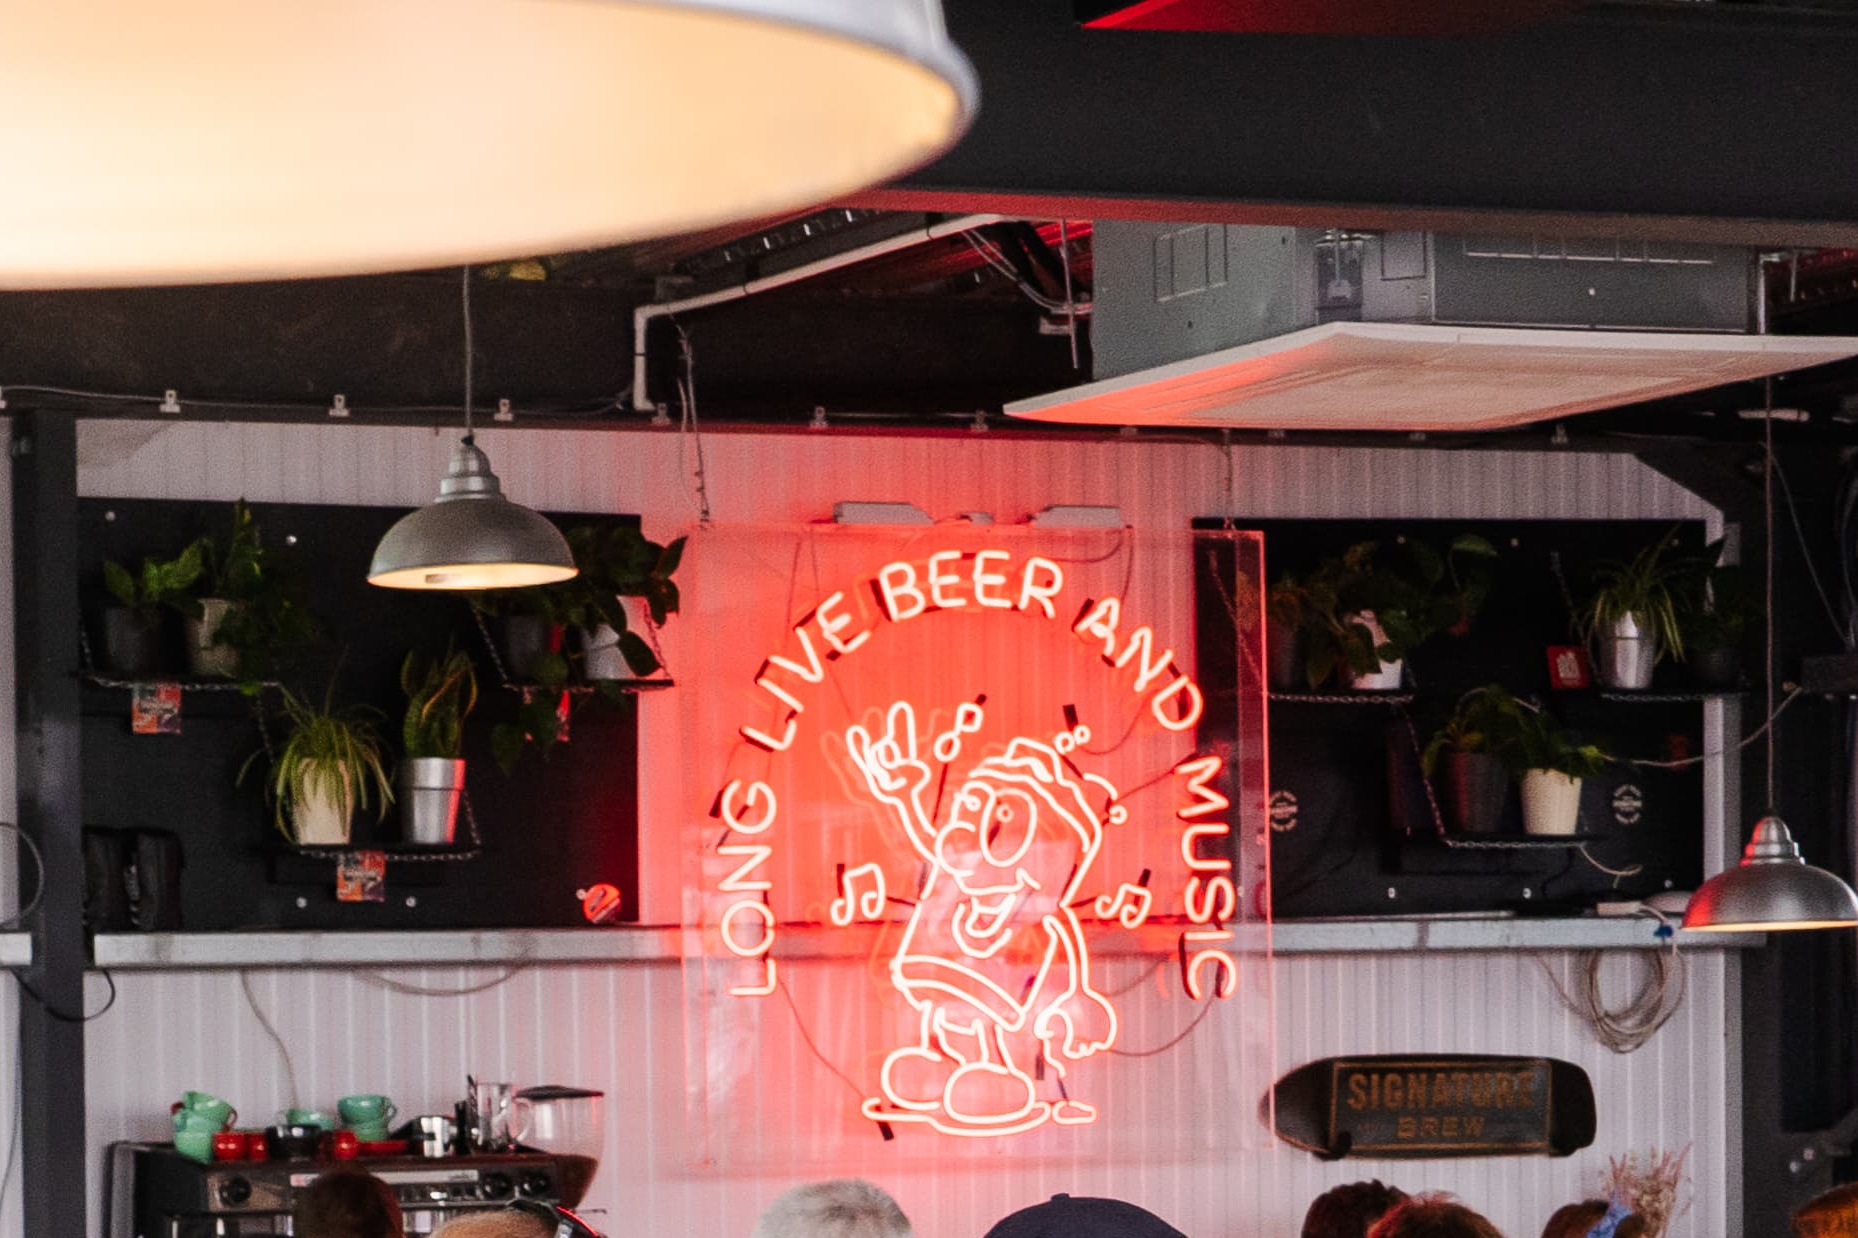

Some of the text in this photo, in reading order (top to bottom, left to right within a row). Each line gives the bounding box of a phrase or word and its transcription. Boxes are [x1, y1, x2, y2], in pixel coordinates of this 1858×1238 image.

[716, 549, 1239, 1001] LONG LIVE BEER AND MUSIC
[1347, 1072, 1536, 1111] SIGNATURE
[1396, 1116, 1487, 1139] BREW
